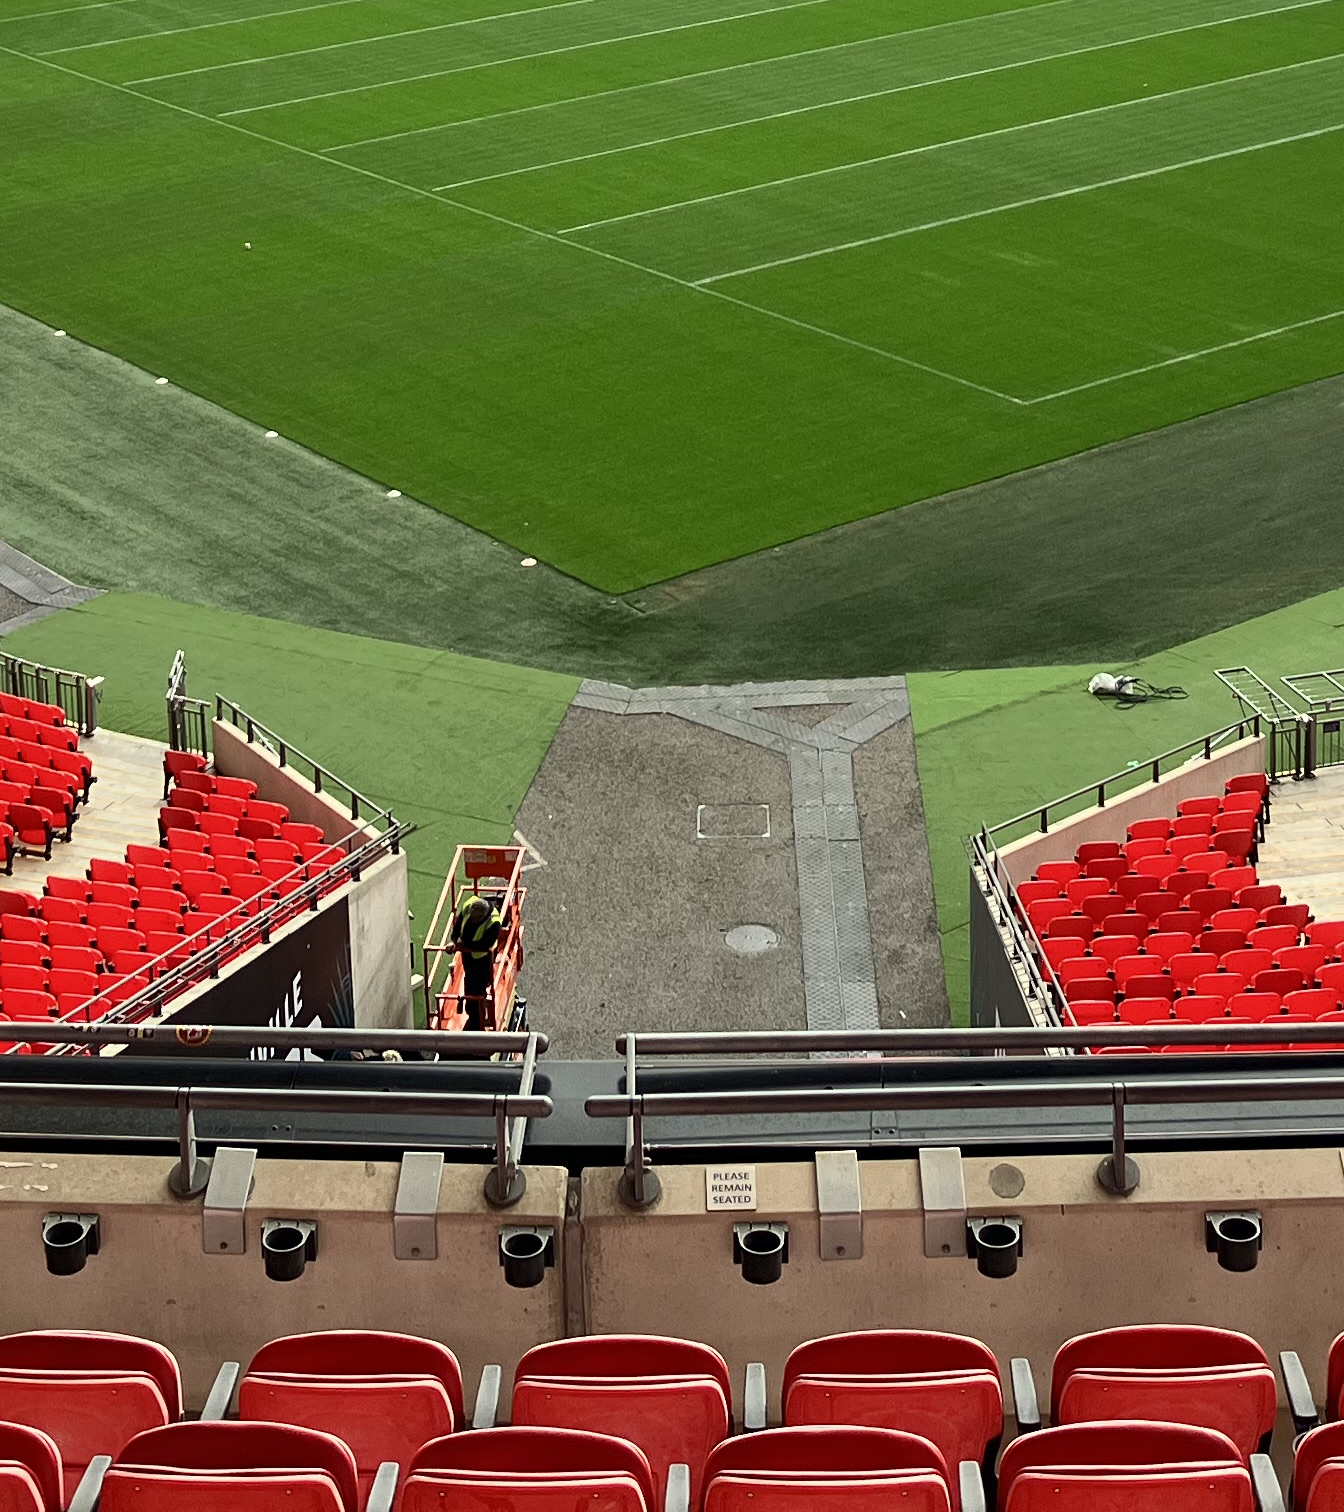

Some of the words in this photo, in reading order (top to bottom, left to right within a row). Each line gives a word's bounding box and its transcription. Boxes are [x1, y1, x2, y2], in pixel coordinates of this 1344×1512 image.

[713, 1172, 750, 1180] PLEASE
[711, 1184, 752, 1192] REMAIN
[712, 1195, 752, 1204] SEATED
